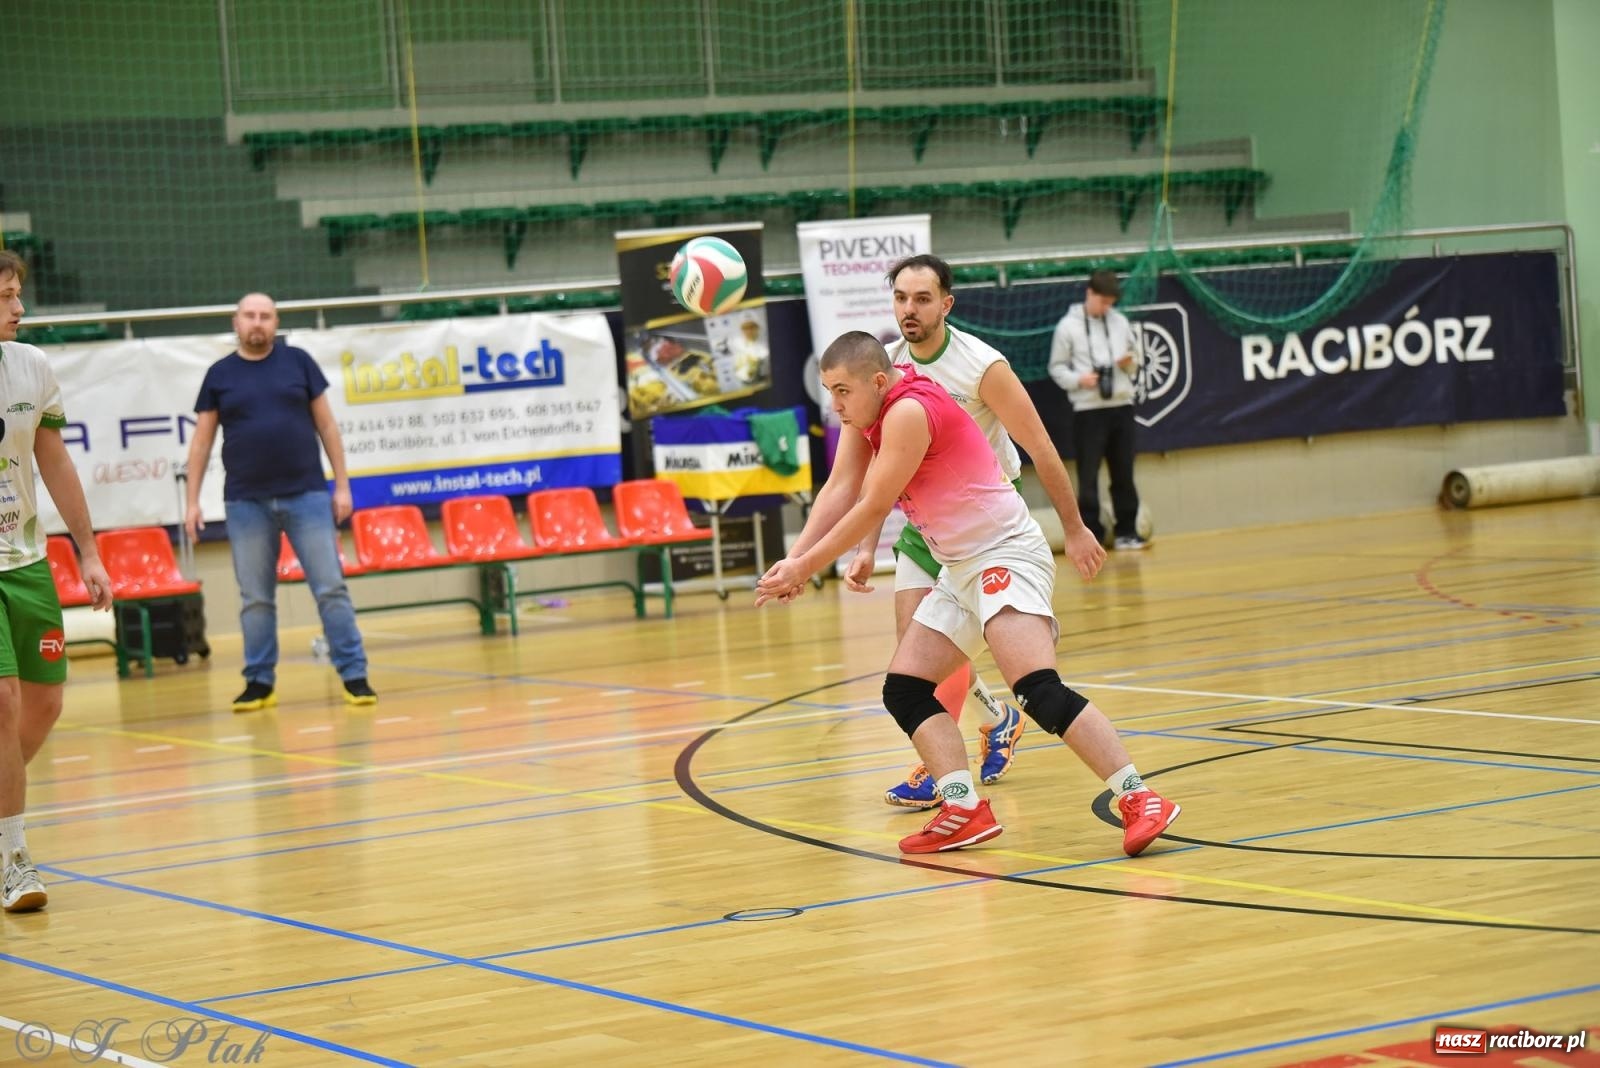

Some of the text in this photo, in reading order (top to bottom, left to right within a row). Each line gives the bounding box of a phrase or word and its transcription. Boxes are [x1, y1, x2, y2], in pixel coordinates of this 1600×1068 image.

[819, 234, 916, 260] PIVEXIN
[1241, 305, 1494, 381] RACIBÓRZ
[341, 339, 566, 400] instal-tech
[586, 420, 594, 433] 2
[391, 467, 542, 497] www.instal-tech.pl
